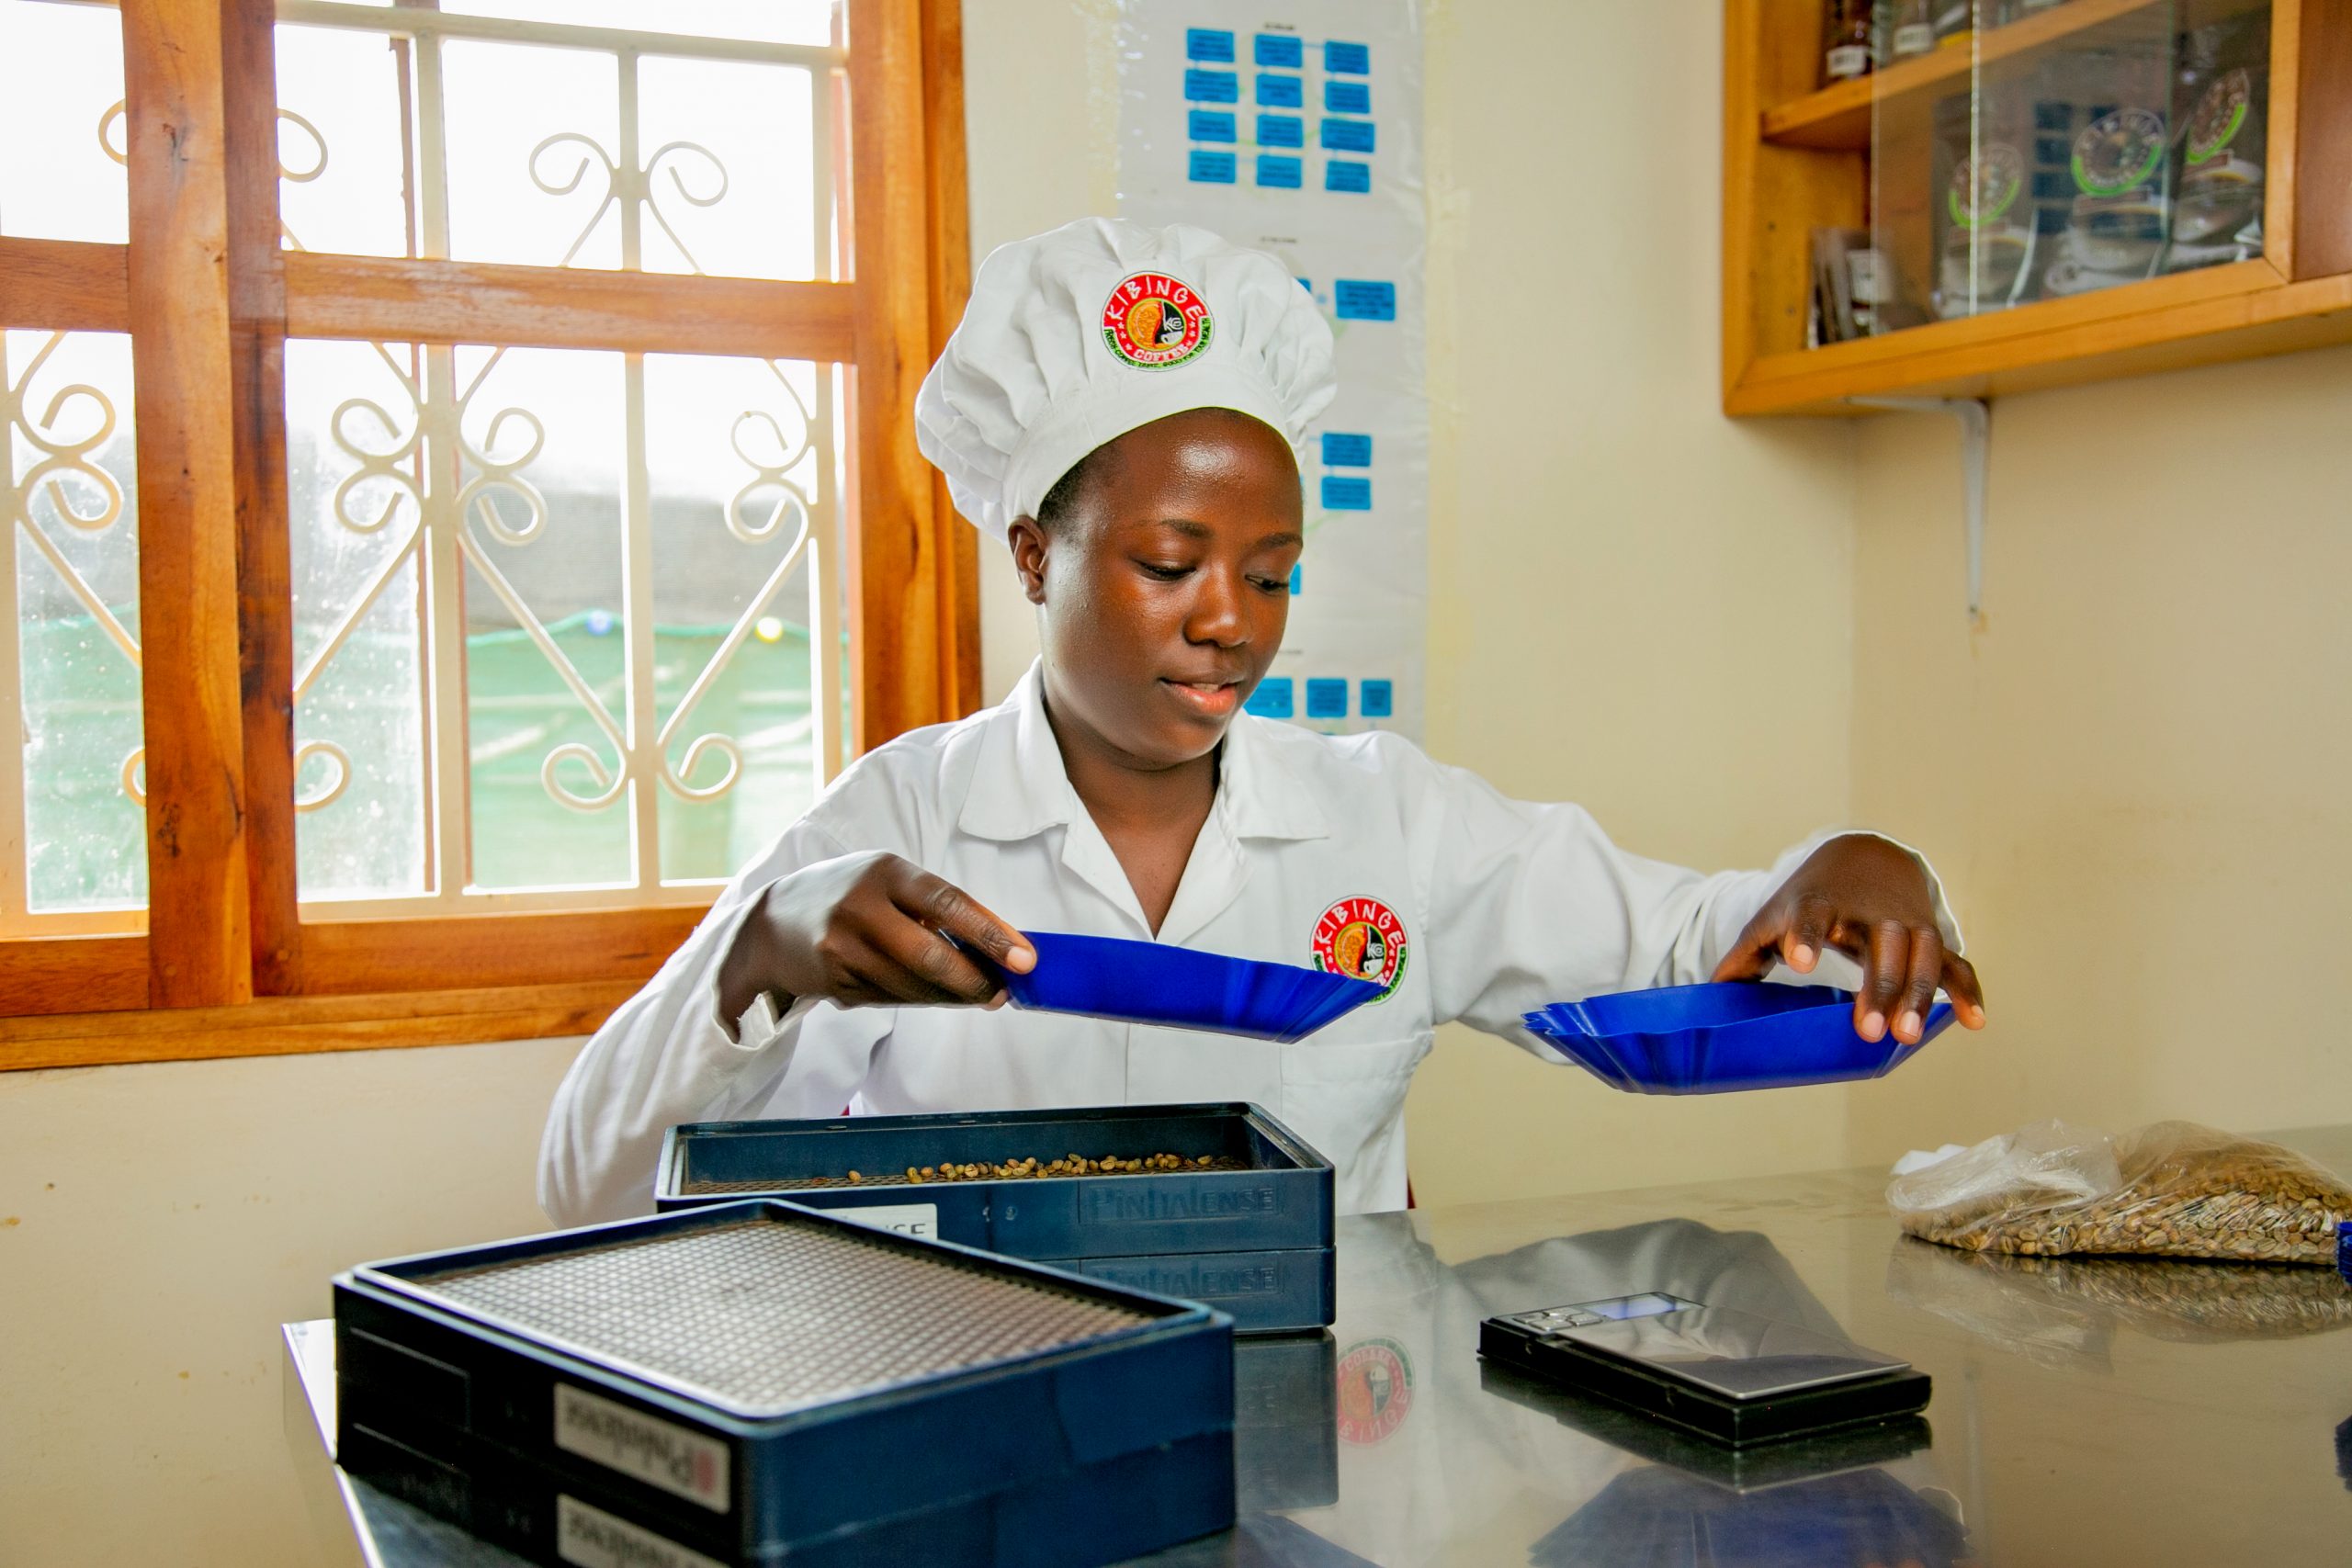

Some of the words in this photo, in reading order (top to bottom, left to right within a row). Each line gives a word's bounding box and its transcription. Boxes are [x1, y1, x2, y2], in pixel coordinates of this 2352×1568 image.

[1106, 276, 1204, 321] KIBINGE
[1135, 344, 1189, 362] COFFEE
[1316, 900, 1404, 949] KIBINGE
